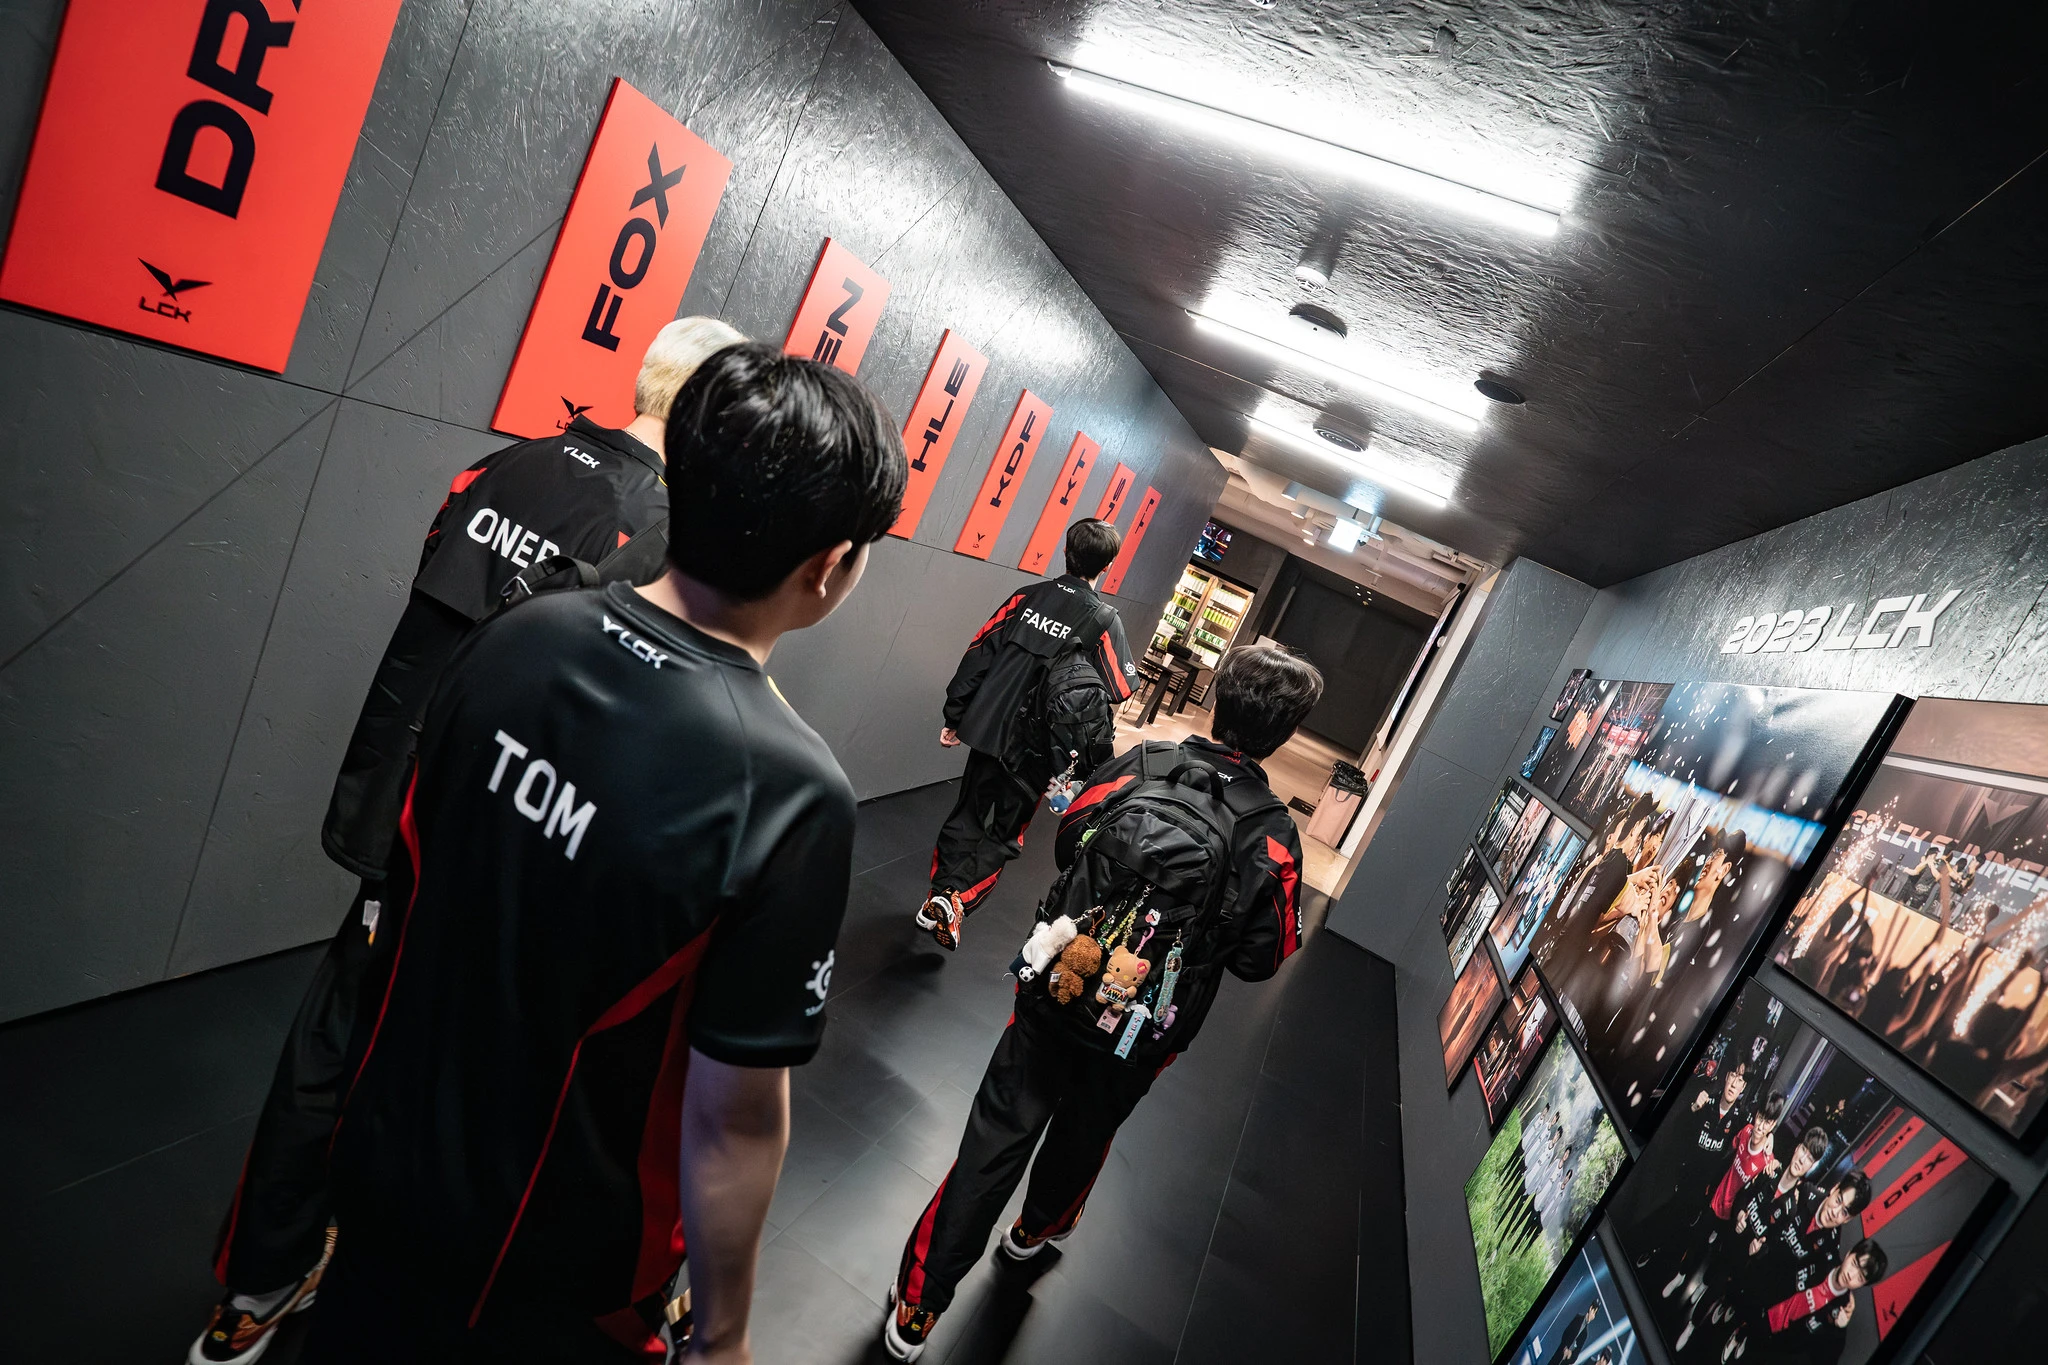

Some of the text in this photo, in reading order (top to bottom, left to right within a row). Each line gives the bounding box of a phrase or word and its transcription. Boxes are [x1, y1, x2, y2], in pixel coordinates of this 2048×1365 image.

[155, 0, 300, 220] DR
[582, 141, 687, 353] FOX
[138, 296, 192, 323] LCK
[810, 276, 864, 368] EN
[910, 356, 970, 473] HLE
[571, 446, 601, 469] LCK
[989, 410, 1037, 508] KDF
[1059, 448, 1086, 506] KT
[618, 629, 670, 670] LCK
[1019, 606, 1073, 641] FAKER
[1719, 589, 1963, 655] 2023 LCK
[487, 728, 599, 862] TOM
[1878, 822, 1932, 853] LCK
[1883, 1151, 1951, 1210] DRX
